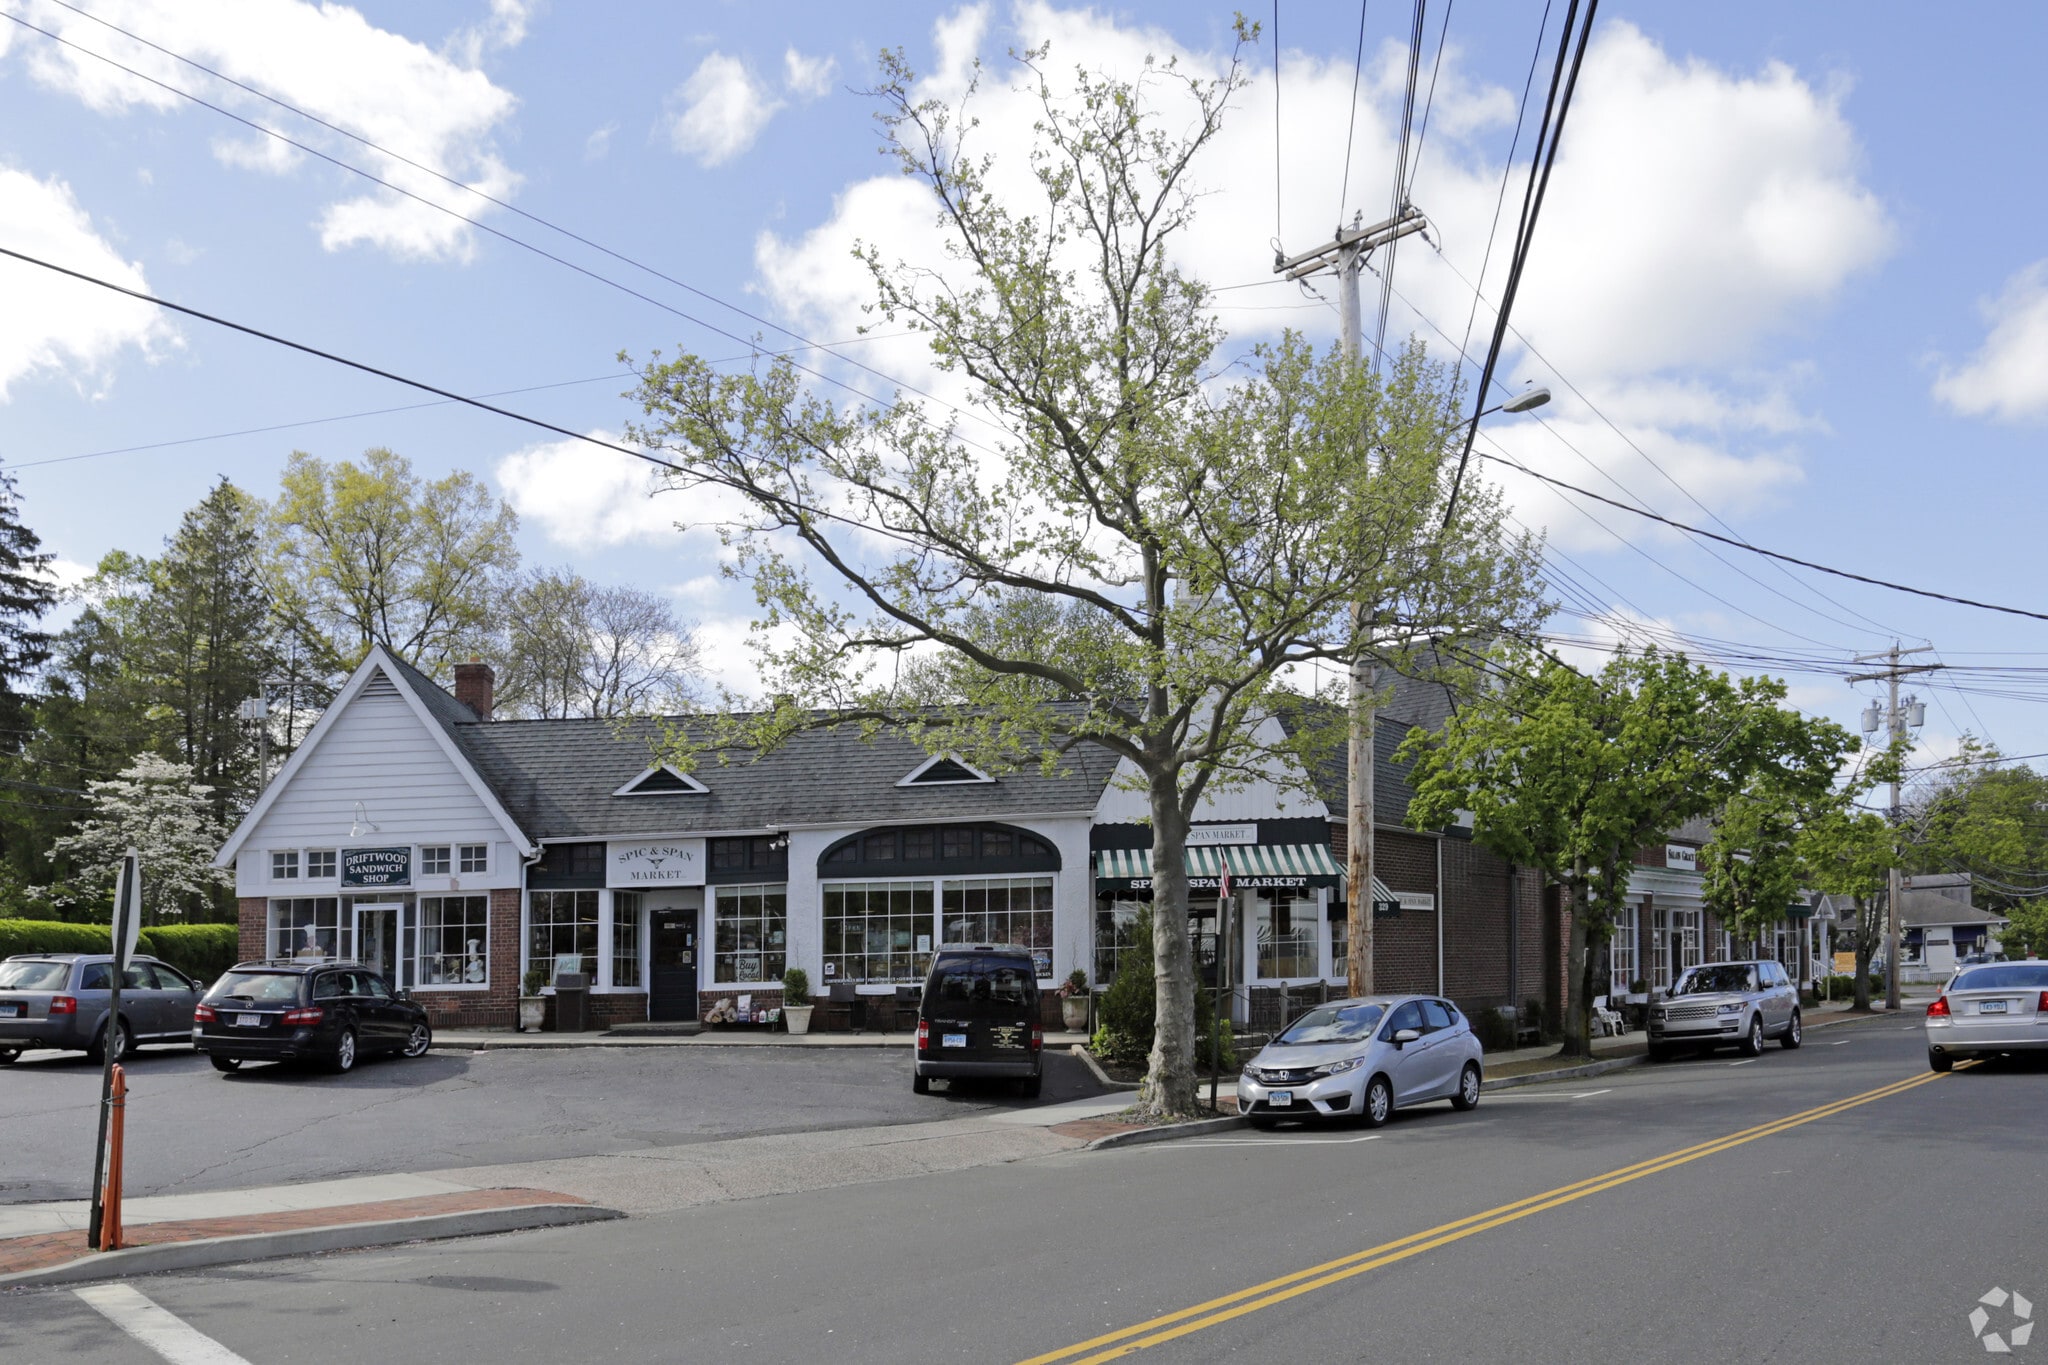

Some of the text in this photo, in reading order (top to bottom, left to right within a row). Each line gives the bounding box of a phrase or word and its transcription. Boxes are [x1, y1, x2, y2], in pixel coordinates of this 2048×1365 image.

[1191, 830, 1245, 839] SPAN MARKET
[346, 852, 407, 866] DRIFTWOOD
[619, 846, 694, 864] SPIC & SPAN
[349, 864, 402, 874] SANDWICH
[363, 874, 389, 883] SHOP
[631, 870, 681, 880] MARKET
[1235, 877, 1306, 887] MARKET
[739, 959, 757, 972] Buy
